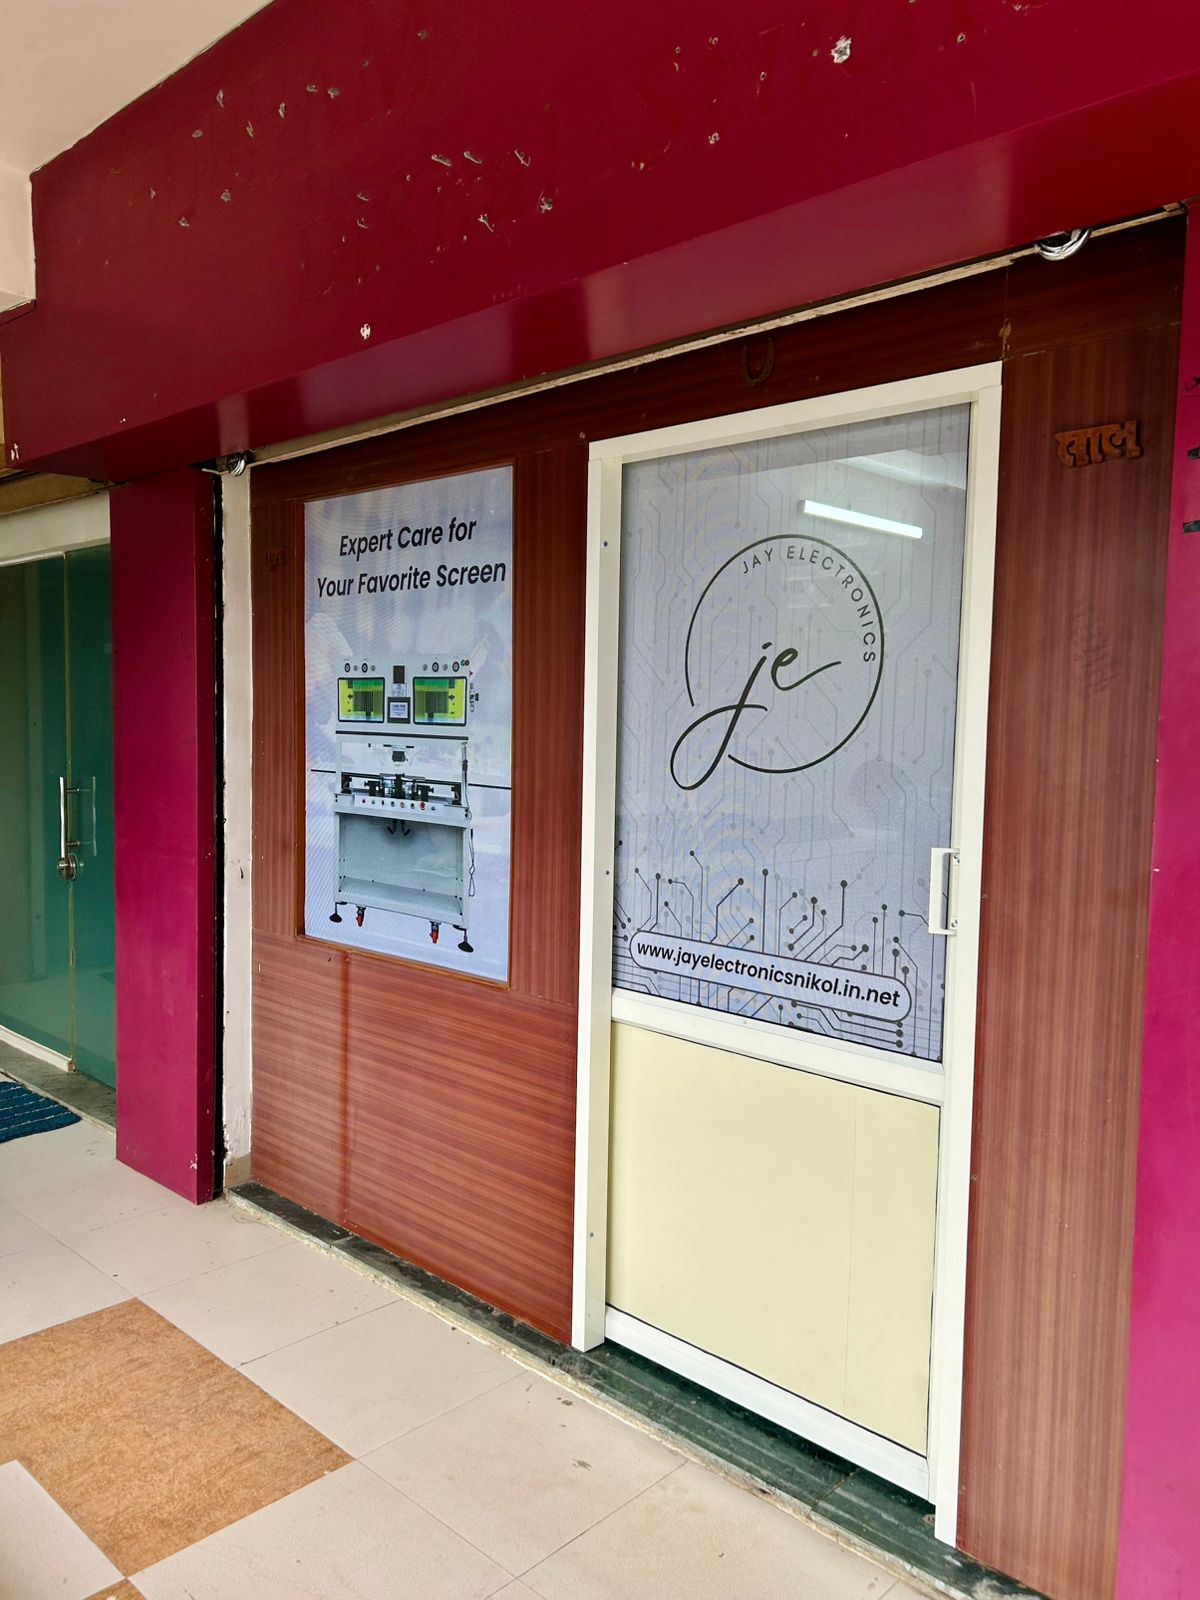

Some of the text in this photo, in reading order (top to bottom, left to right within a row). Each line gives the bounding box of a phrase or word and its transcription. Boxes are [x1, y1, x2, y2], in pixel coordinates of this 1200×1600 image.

[339, 517, 477, 562] Expert Care for
[317, 562, 506, 598] Your Favorite Screen
[742, 545, 876, 663] JAY ELECTRONICS
[637, 941, 901, 1007] www.jayelectronicsnikol.in.net
